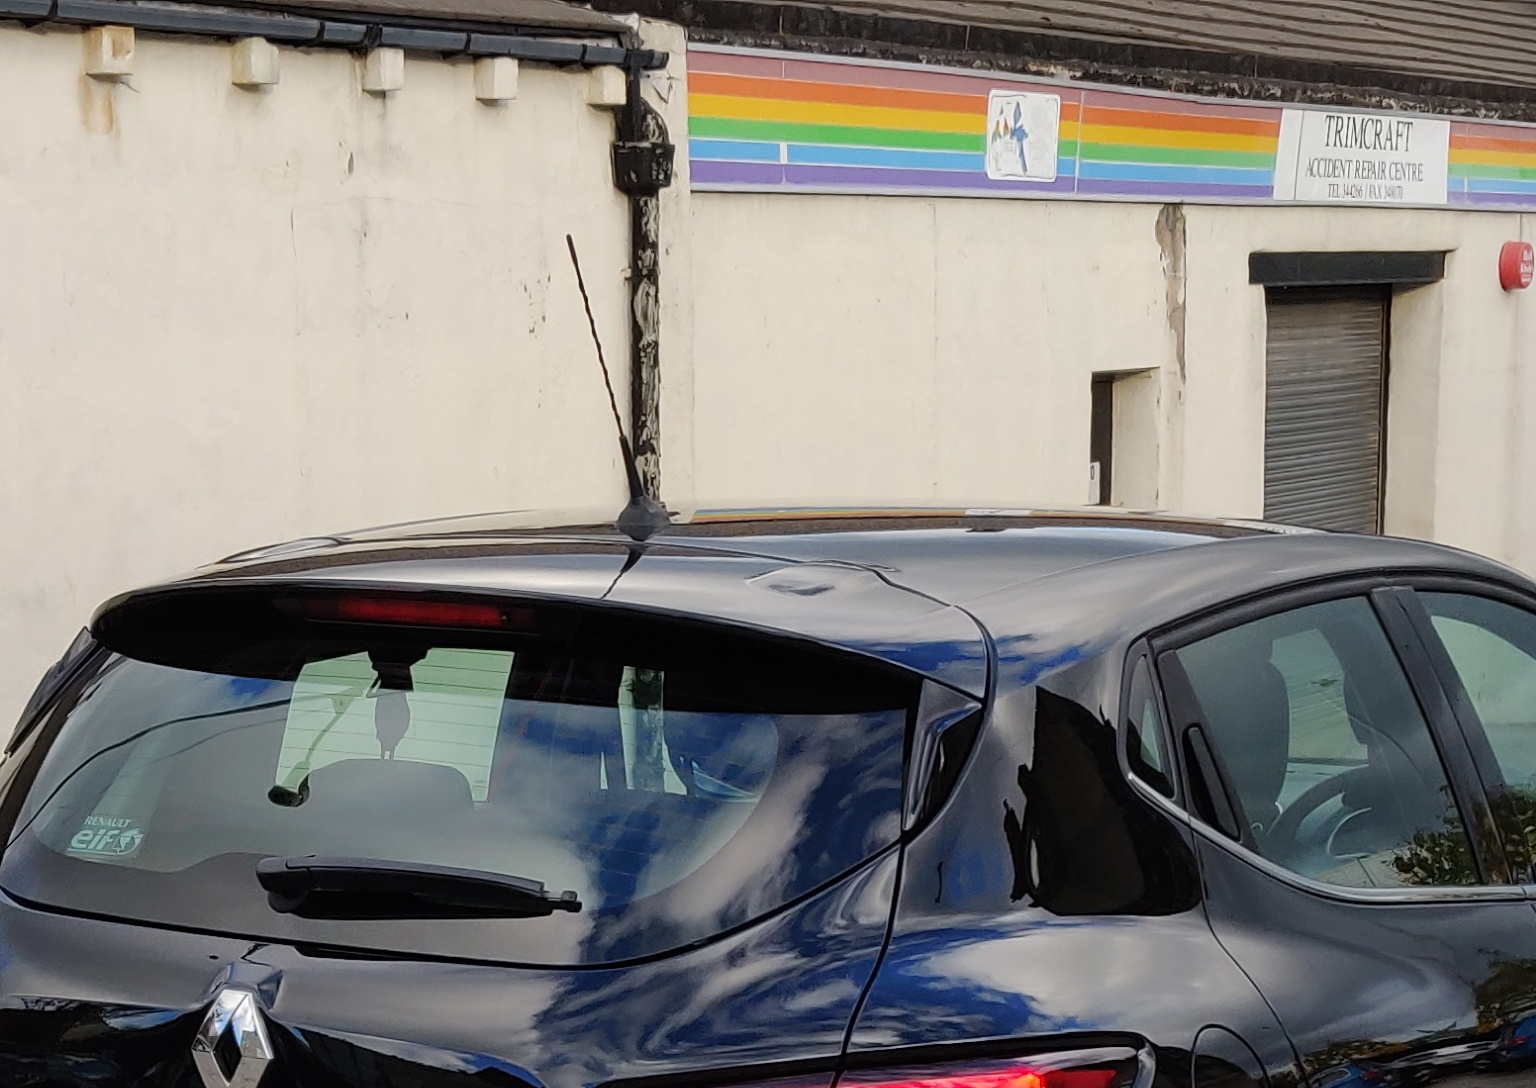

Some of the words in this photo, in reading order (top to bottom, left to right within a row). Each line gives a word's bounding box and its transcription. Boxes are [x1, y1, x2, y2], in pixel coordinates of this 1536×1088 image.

[1325, 114, 1413, 152] TRIMCRAFT
[1305, 157, 1353, 179] ACCIDENT
[1354, 160, 1387, 181] REPAIR
[1389, 162, 1424, 182] CENTRE
[1328, 183, 1340, 198] TEL
[1369, 184, 1382, 200] FAX
[84, 816, 132, 828] RENAULT
